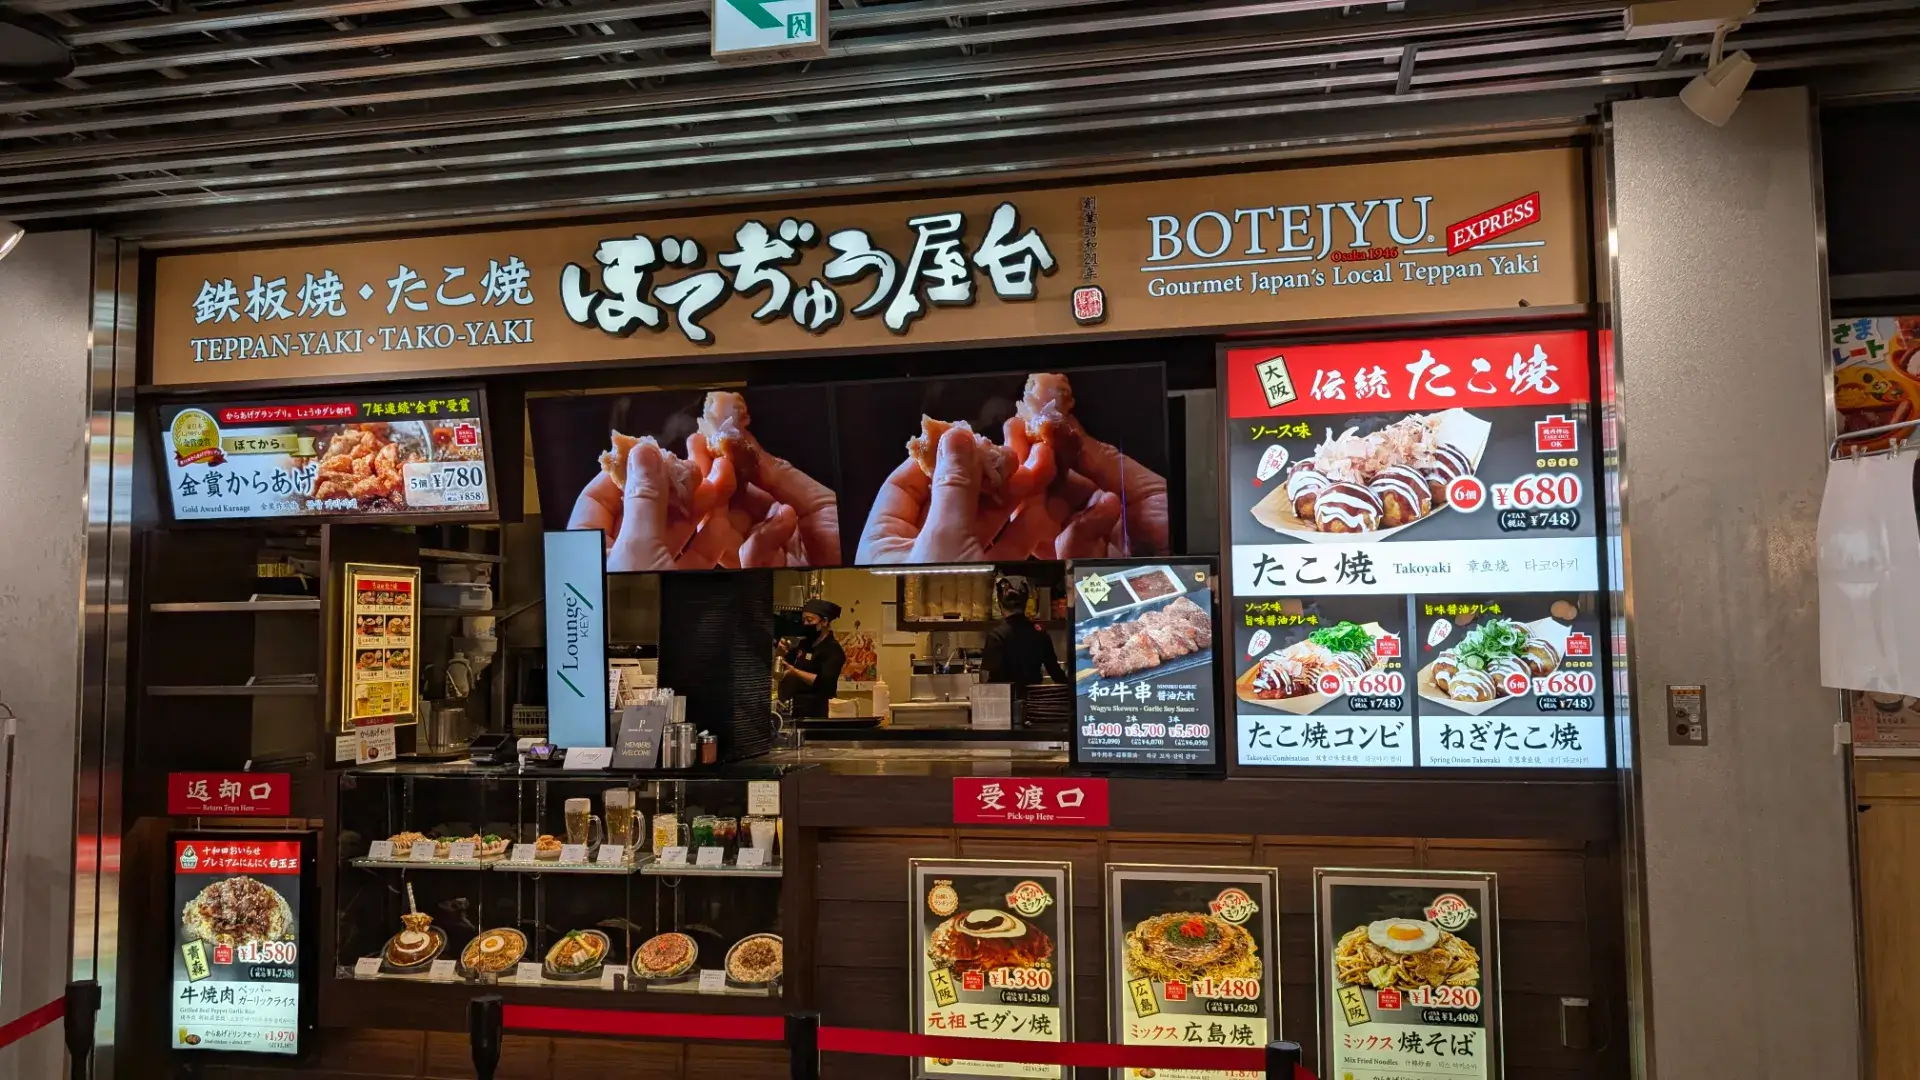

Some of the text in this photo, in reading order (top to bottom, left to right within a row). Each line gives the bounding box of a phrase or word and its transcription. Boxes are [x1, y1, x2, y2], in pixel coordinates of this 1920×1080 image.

[1147, 196, 1434, 262] BOTEJYU
[1453, 199, 1534, 248] EXPRESS
[1082, 196, 1099, 280] 創業昭和21年
[1331, 246, 1399, 262] Osaka 1946
[560, 200, 1058, 346] ぼてぢゅう屋台
[1148, 274, 1243, 297] Gourmet
[1333, 262, 1391, 285] Local
[1400, 259, 1484, 287] Teppan
[1489, 254, 1540, 275] Yaki
[1264, 362, 1291, 400] 大阪
[1310, 344, 1560, 401] 伝統 たこ焼
[1250, 422, 1312, 440] ソース味
[234, 439, 280, 450] ぼてから
[1550, 440, 1563, 448] OK
[178, 464, 317, 497] 金賞からあげ
[411, 478, 427, 489] 5個
[433, 467, 483, 487] ¥780
[1454, 486, 1477, 501] 6個
[1496, 476, 1578, 506] ¥680
[223, 504, 251, 514] Karaage
[1252, 551, 1377, 587] たこ焼
[1393, 562, 1452, 576] Takoyaki
[1524, 558, 1579, 573] 타코야키
[1245, 601, 1282, 612] ソース味
[562, 597, 582, 671] Lounge
[580, 612, 589, 637] KEY
[1088, 681, 1152, 704] 和牛串
[1322, 680, 1337, 689] 6個
[1347, 674, 1402, 693] ¥680
[1509, 679, 1525, 689] 6個
[1536, 673, 1593, 693] ¥680
[1090, 705, 1111, 713] Wagyu
[1083, 724, 1209, 738] ¥1,900 ¥3,700 ¥5,500
[1249, 721, 1404, 750] たこ焼コンビ
[1440, 721, 1582, 751] ねぎたこ焼
[622, 749, 651, 757] WELCOME
[625, 741, 652, 749] MEMBERS
[1246, 755, 1272, 763] Takoyaki
[1430, 757, 1450, 765] Spring
[1473, 757, 1500, 765] Takoyaki
[187, 779, 272, 803] 返却口
[977, 783, 1085, 811] 受渡口
[224, 805, 240, 813] Trays
[1007, 812, 1035, 821] Pick-up
[202, 846, 261, 855] 十和田おいらせ
[187, 945, 205, 976] 青森
[240, 942, 296, 962] ¥1,580
[935, 973, 953, 1000] 大阪
[991, 970, 1050, 989] ¥1,380
[1196, 979, 1258, 998] ¥1,480
[180, 985, 271, 1005] 牛焼肉 ペッパー
[238, 996, 296, 1007] ガーリックライス
[1136, 983, 1152, 1012] 広島
[1413, 986, 1478, 1007] ¥1,280
[1344, 991, 1365, 1020] 大阪
[928, 1010, 1052, 1035] 元祖 モダン焼
[1131, 1021, 1255, 1046] ミックス 広島焼
[1343, 1031, 1476, 1056] ミックス 焼そば
